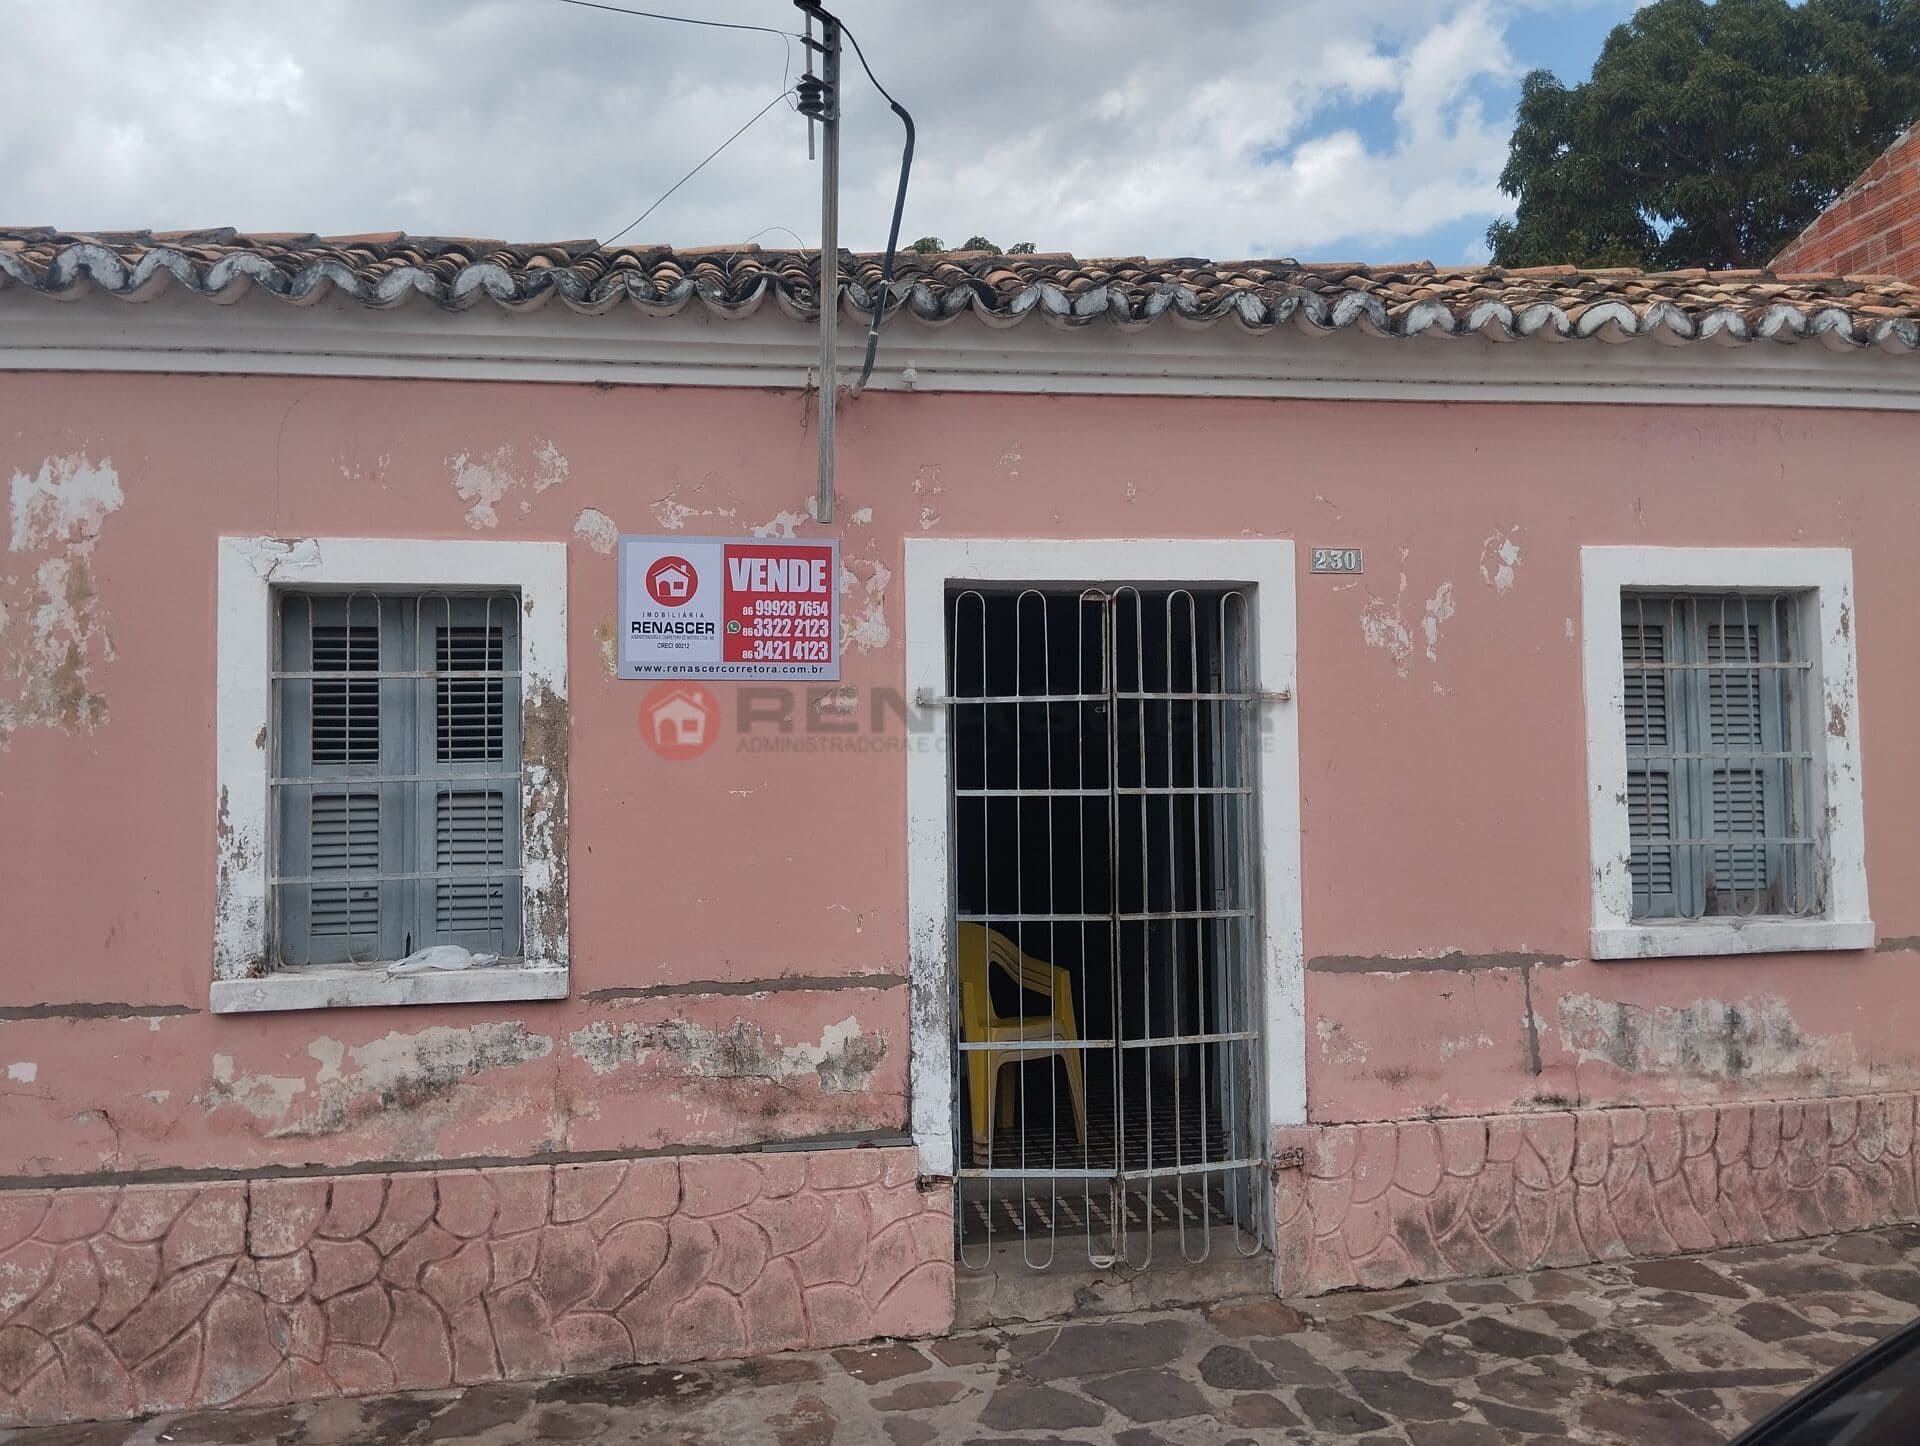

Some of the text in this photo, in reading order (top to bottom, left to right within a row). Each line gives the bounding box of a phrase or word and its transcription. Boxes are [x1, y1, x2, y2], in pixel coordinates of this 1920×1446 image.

[1315, 551, 1356, 570] 230
[728, 557, 827, 593] VENDE
[742, 599, 829, 616] 86 99928 7654
[631, 621, 715, 634] RENASCER
[742, 617, 829, 637] 86 3322 2123
[742, 640, 829, 660] 86 3421 4123
[634, 664, 824, 674] www.renascercorretora.com.br
